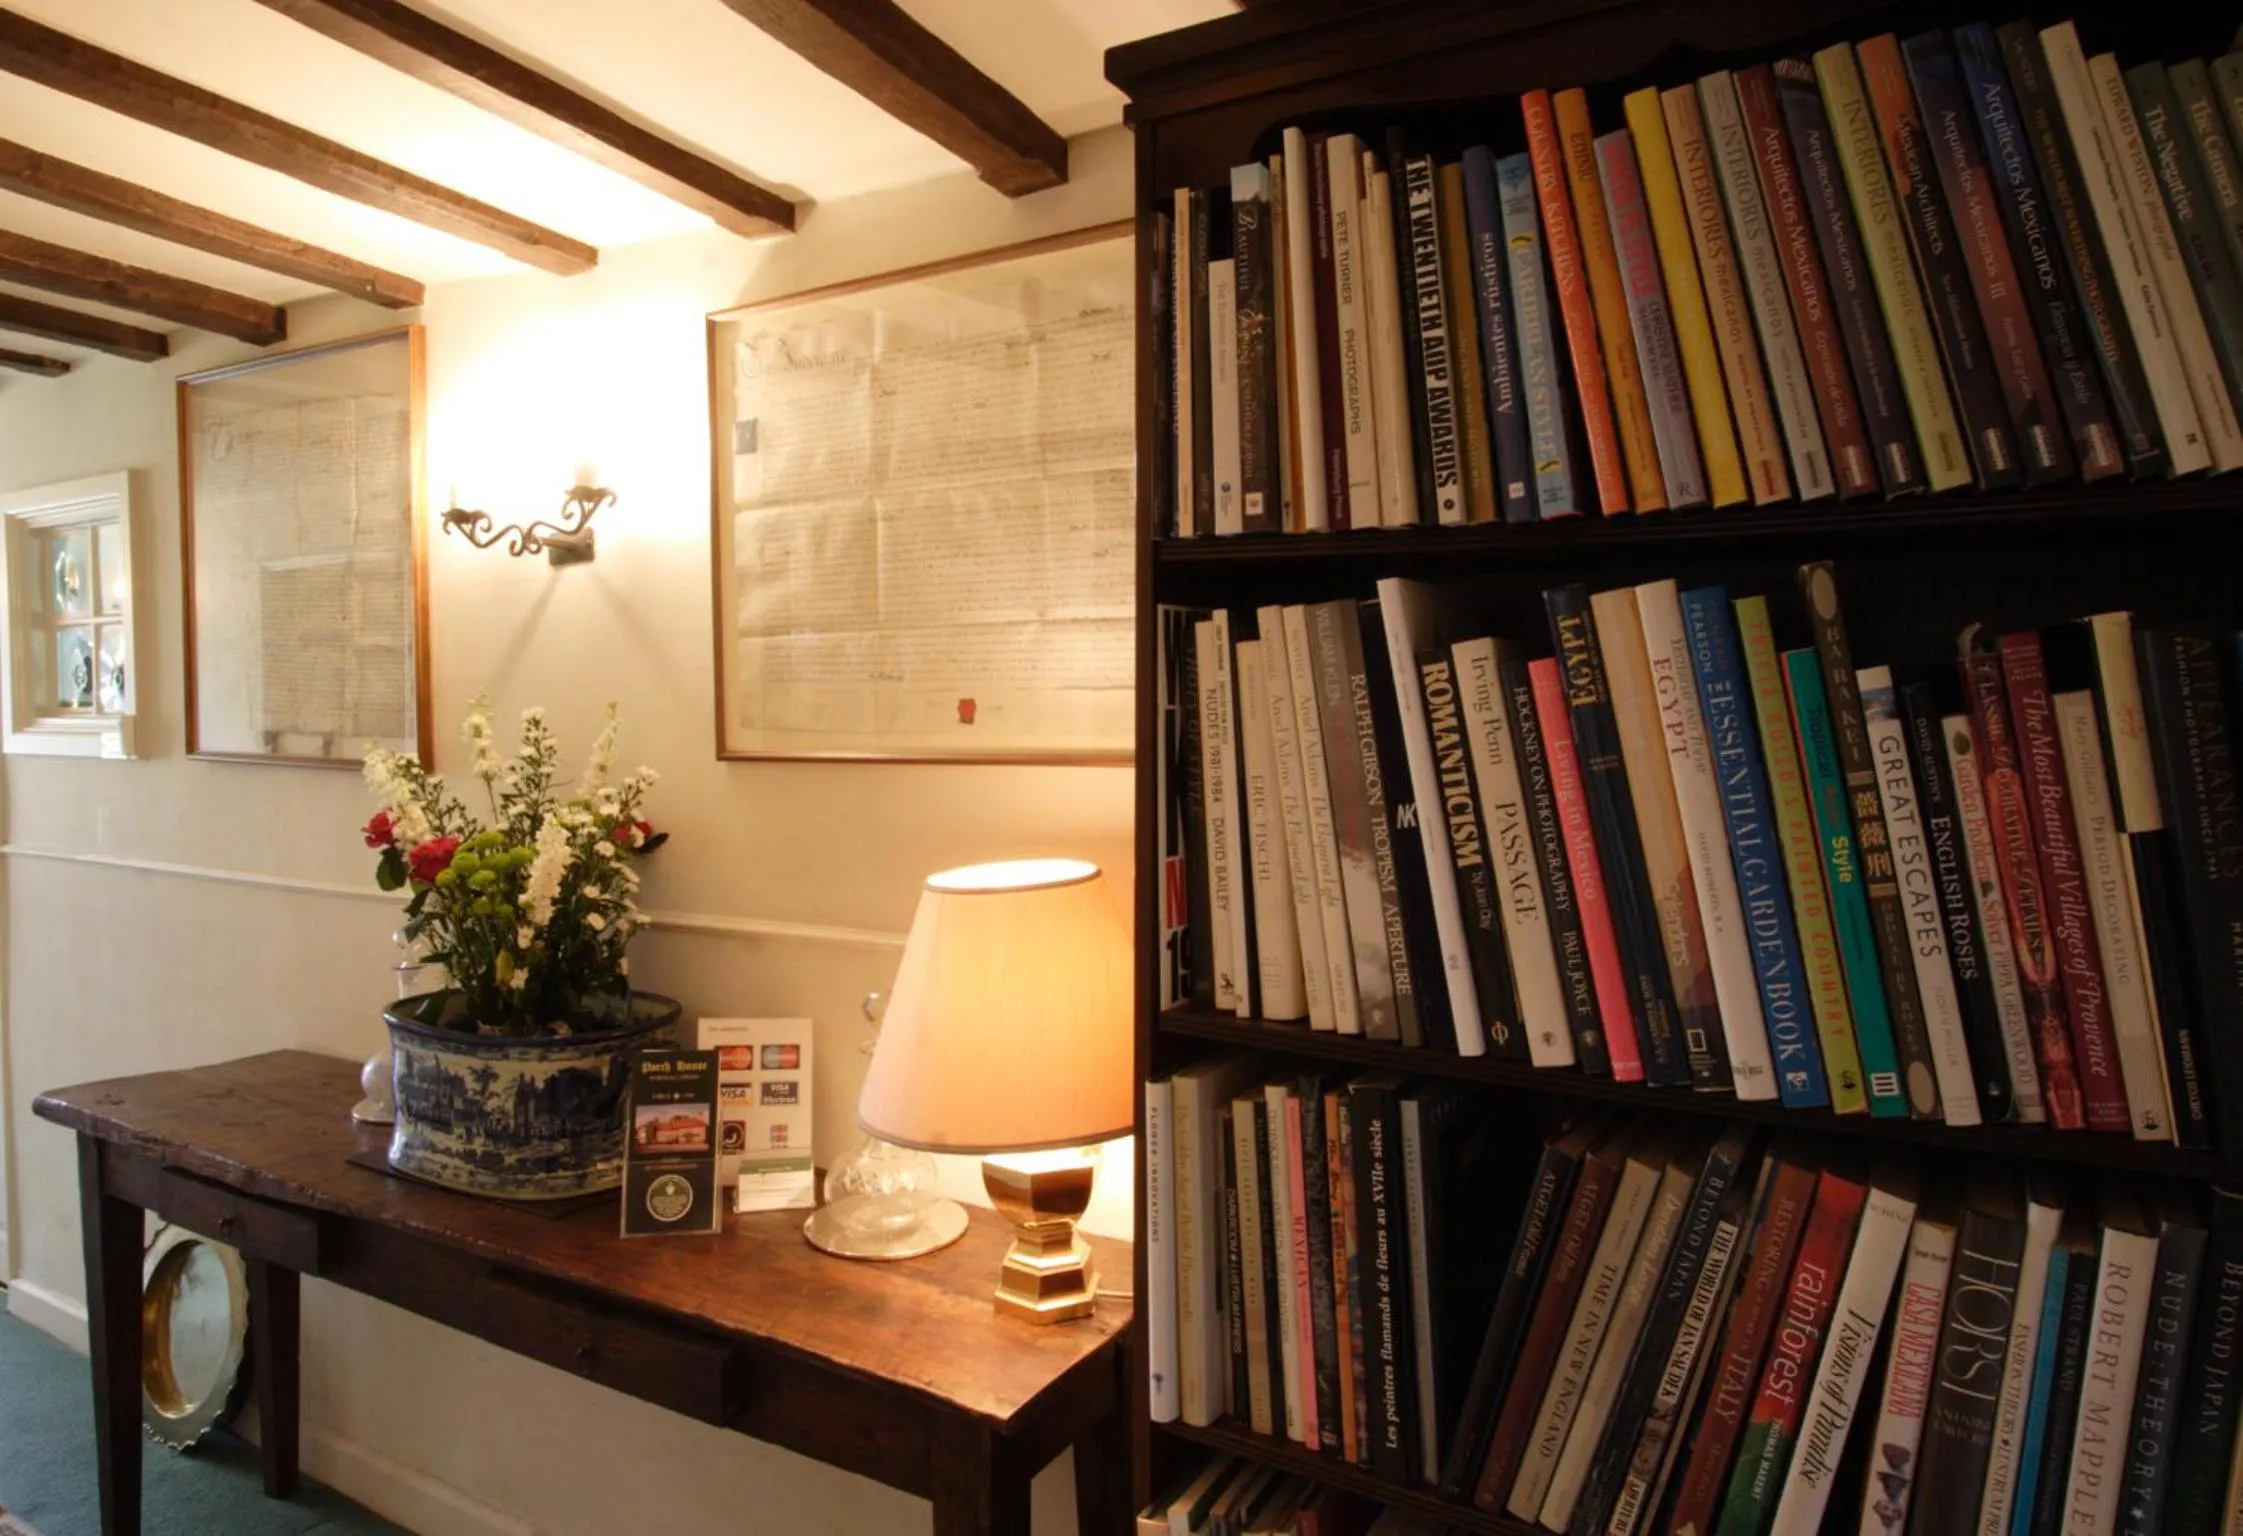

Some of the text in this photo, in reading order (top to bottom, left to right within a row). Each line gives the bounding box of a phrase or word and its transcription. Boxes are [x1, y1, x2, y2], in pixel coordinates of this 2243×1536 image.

[1894, 114, 1947, 256] Mexican Architects
[1976, 78, 2028, 188] Arquitectos
[2014, 185, 2057, 291] Mexicanos
[2104, 76, 2154, 195] EDWARD WESTON
[2141, 103, 2198, 223] The Negative
[2189, 98, 2241, 209] The Camera
[1527, 105, 1578, 295] COUNTRY KITCHENS
[1683, 137, 1744, 342] INTERIORES mexicanos
[1719, 120, 1785, 337] INTERIORES mexicanos
[1759, 120, 1824, 320] Arquitectos Mexicanos
[1804, 127, 1859, 290] Arquitectos Mexicanos
[1841, 97, 1913, 316] INTERIORES mexicanos
[1938, 106, 2005, 298] Arquitectos Mexicanos III
[1335, 210, 1361, 433] PETE TURNER PHOTOGRAPHS
[1405, 155, 1457, 487] THE TWENTIETH AWARDS
[1475, 230, 1514, 415] Ambientes rústicos
[1510, 245, 1561, 458] CARIBBEAN STYLE
[1314, 605, 1343, 709] WILLIAM KLEIN
[1553, 610, 1599, 710] EGYPT
[1687, 601, 1716, 675] PEARSON
[1204, 687, 1220, 739] NUDES
[1270, 692, 1289, 732] Ansel
[1275, 737, 1295, 786] Adams
[1298, 691, 1318, 733] Ansel
[1305, 738, 1325, 787] Adams
[1419, 658, 1485, 869] ROMANTICISM
[1651, 653, 1691, 760] EGYPT
[2171, 634, 2215, 843] FASHION PHOTOGRAPHY SINCE
[2184, 631, 2243, 879] APPEARANCES
[1207, 744, 1223, 803] 1981-1984
[1250, 772, 1271, 885] ERIC FISCHL
[1283, 793, 1300, 816] The
[1311, 795, 1328, 817] The
[1463, 653, 1539, 925] Irving Penn PASSAGE
[1548, 736, 1600, 901] Living in Mexico
[1803, 704, 1836, 780] Tropical
[1827, 832, 1857, 886] Style
[1211, 816, 1226, 861] DAVID
[1213, 864, 1229, 912] BAILEY
[1350, 672, 1411, 996] RALPH GIBSON TROPISM APERTURE
[1512, 684, 1592, 1018] HOCKNEY ON PHOTOGRAPHY PAUL JOYCE
[1707, 692, 1806, 1064] ESSENTIAL GARDEN BOOK
[1876, 733, 1941, 958] GREAT ESCAPES
[1928, 813, 1967, 909] ENGLISH
[2019, 687, 2116, 1079] The Most Beautiful Villages of Provence
[2089, 813, 2115, 877] PERIOD
[1787, 816, 1822, 919] PAINTED
[1809, 929, 1846, 1042] COUNTRY
[1946, 908, 1981, 981] ROSES
[1953, 755, 2037, 1085] Garden Problem Solver PIPPA GREENWOOD
[2099, 876, 2135, 986] DECORATING
[720, 1088, 747, 1100] VISA
[1367, 1119, 1383, 1158] siècle
[1149, 1162, 1159, 1242] INNOVATIONS
[1292, 1213, 1309, 1288] MEXICAN
[1373, 1229, 1388, 1271] fleurs
[1375, 1208, 1386, 1225] au
[1664, 1174, 1726, 1303] BEYOND JAPAN
[1376, 1274, 1389, 1292] de
[1377, 1297, 1393, 1361] flamands
[1658, 1224, 1737, 1400] THE WORLD OF JAN SAUDEK
[1711, 1194, 1797, 1423] RESTORING ITALY
[1762, 1258, 1836, 1408] rainforest
[1937, 1247, 2019, 1401] HORST
[2056, 1279, 2088, 1391] PAUL STRAND
[2089, 1260, 2134, 1391] ROBERT
[2208, 1259, 2243, 1360] BEYOND
[1380, 1364, 1399, 1423] peintres
[1536, 1259, 1619, 1459] TIME IN NEW ENGLAND
[1794, 1306, 1878, 1490] Visions of Paradise
[1885, 1280, 1942, 1420] CASA MEXICANA
[2000, 1382, 2023, 1435] THEORY
[2193, 1362, 2230, 1439] JAPAN
[1383, 1426, 1398, 1449] Les
[1761, 1415, 1783, 1459] THOMAS
[1613, 1478, 1644, 1534] APERTURE
